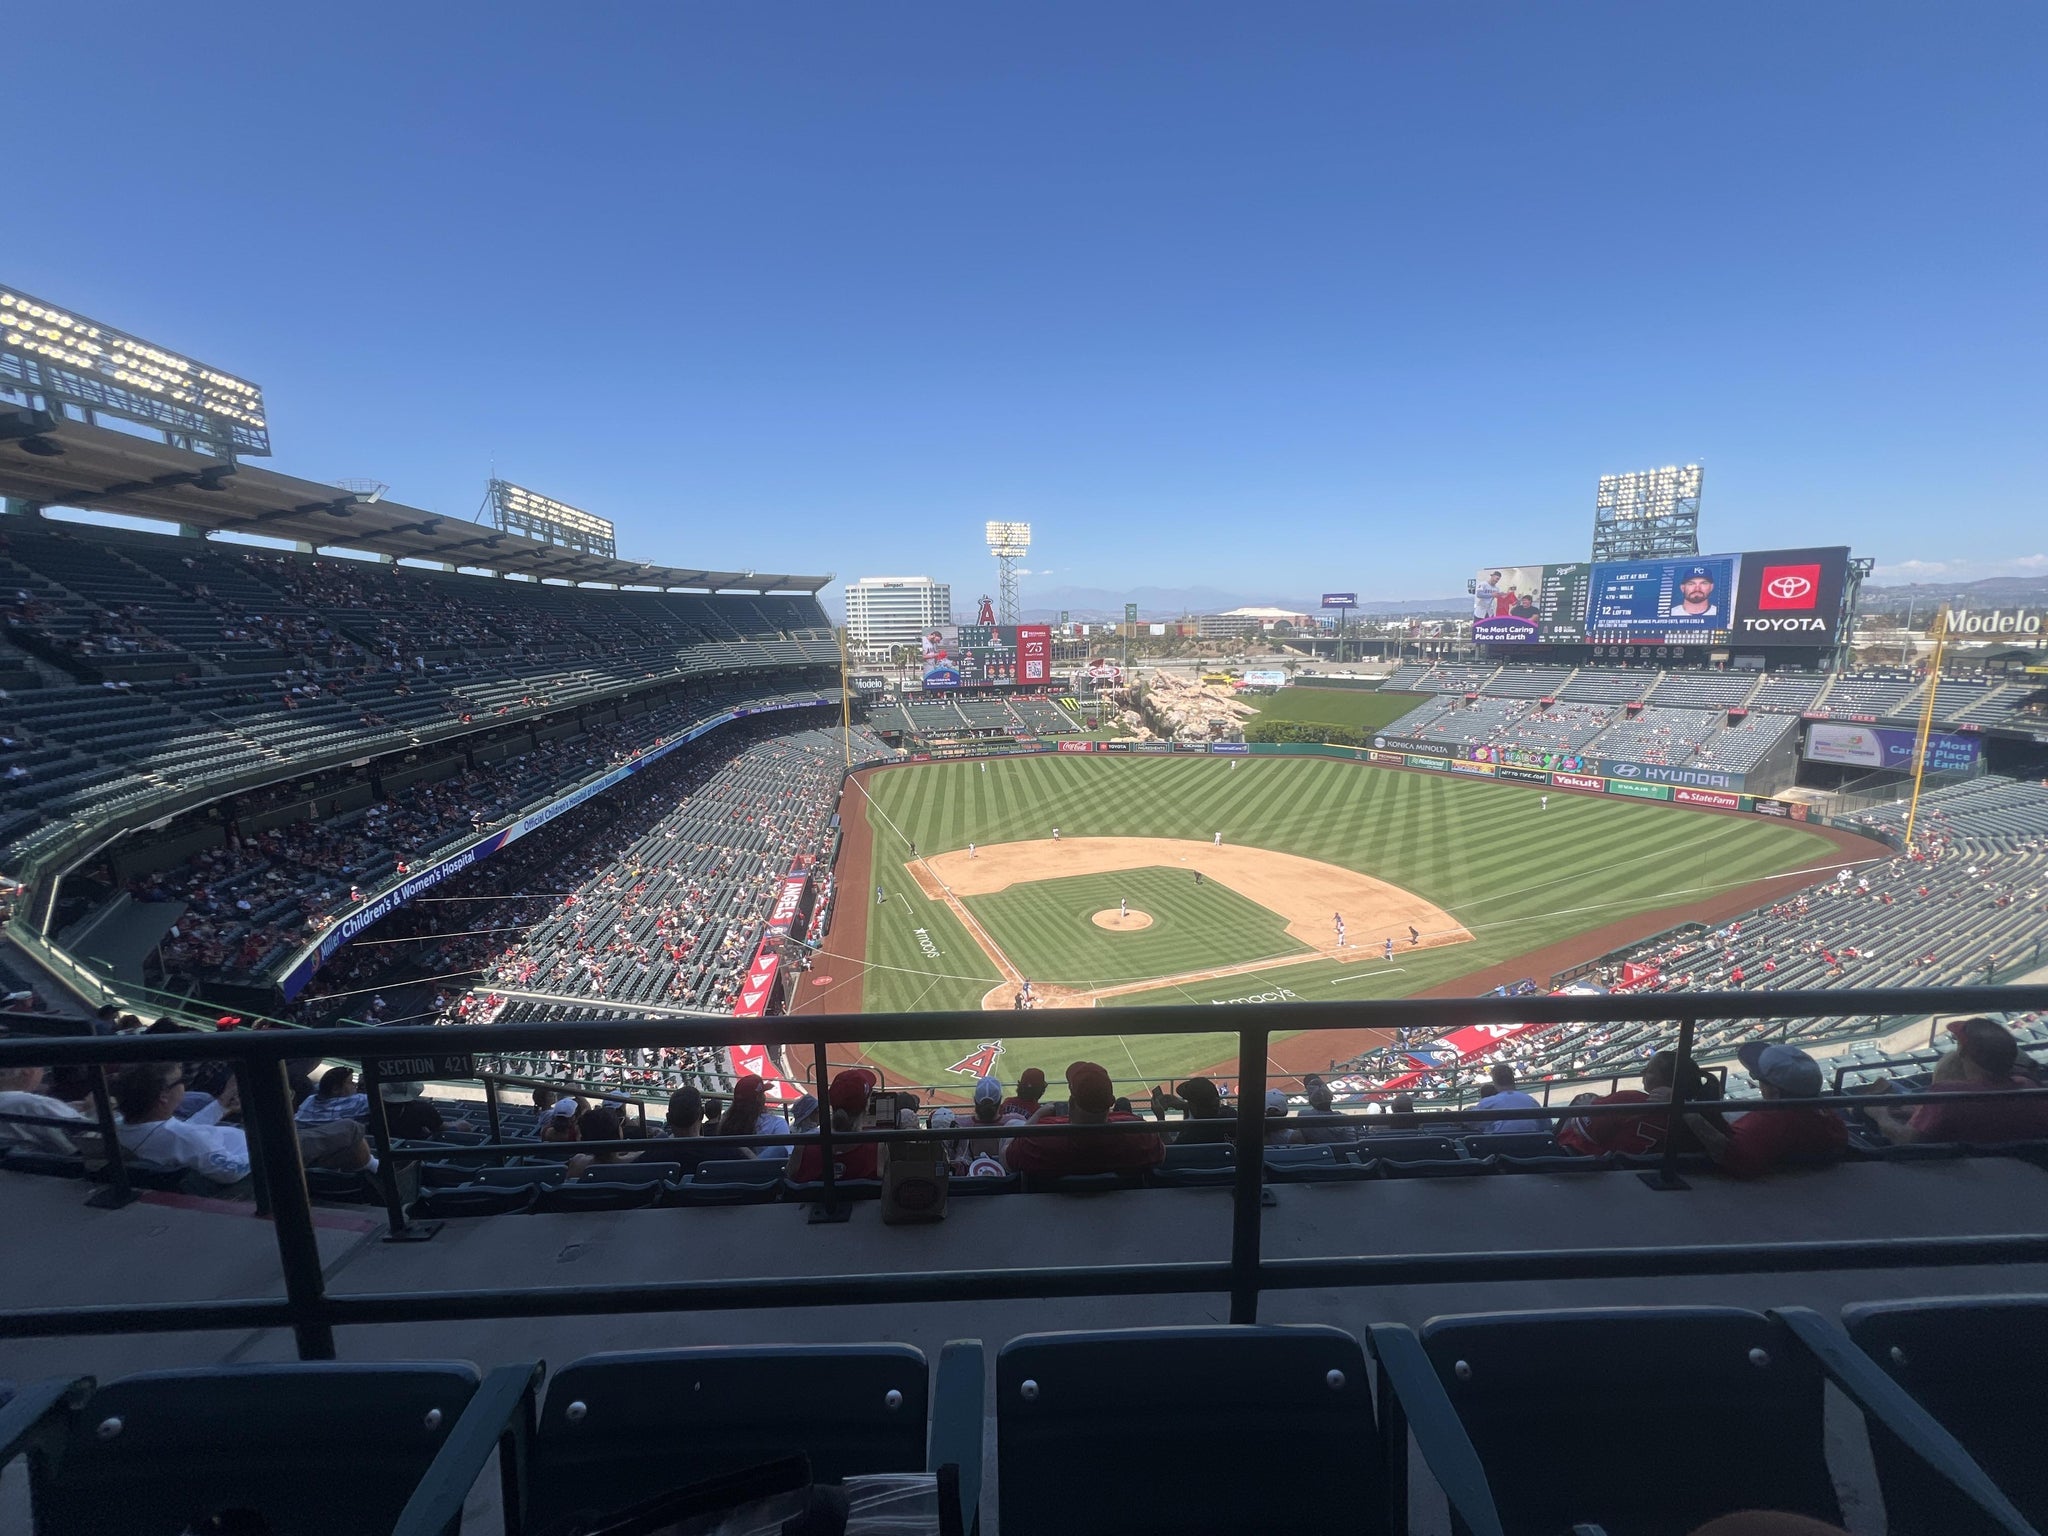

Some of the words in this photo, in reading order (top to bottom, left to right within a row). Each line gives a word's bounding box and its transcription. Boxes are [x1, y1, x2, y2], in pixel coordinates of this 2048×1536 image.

[1694, 567, 1704, 575] KC
[1602, 606, 1611, 615] 12
[1743, 619, 1827, 631] TOYOTA
[1947, 610, 2040, 633] Modelo
[1509, 627, 1534, 635] Caring
[1026, 642, 1043, 653] $75
[1063, 742, 1087, 751] Coca-Cola
[1387, 740, 1415, 751] KONICA
[1416, 744, 1448, 754] MINOLTA
[1939, 740, 1972, 751] Most
[1505, 752, 1544, 763] BEATBOX
[1935, 750, 1971, 761] Place
[1418, 758, 1444, 766] National
[1934, 760, 1969, 770] Earth
[1557, 776, 1600, 789] Yakult
[1645, 769, 1730, 787] HYUNDAI
[321, 930, 341, 961] Miller
[342, 896, 391, 938] Children's
[393, 891, 401, 905] &
[401, 868, 441, 900] Women's
[442, 849, 475, 881] Hospital
[774, 883, 804, 920] ANGELS
[378, 1058, 435, 1076] SECTION
[445, 1056, 468, 1072] 421
